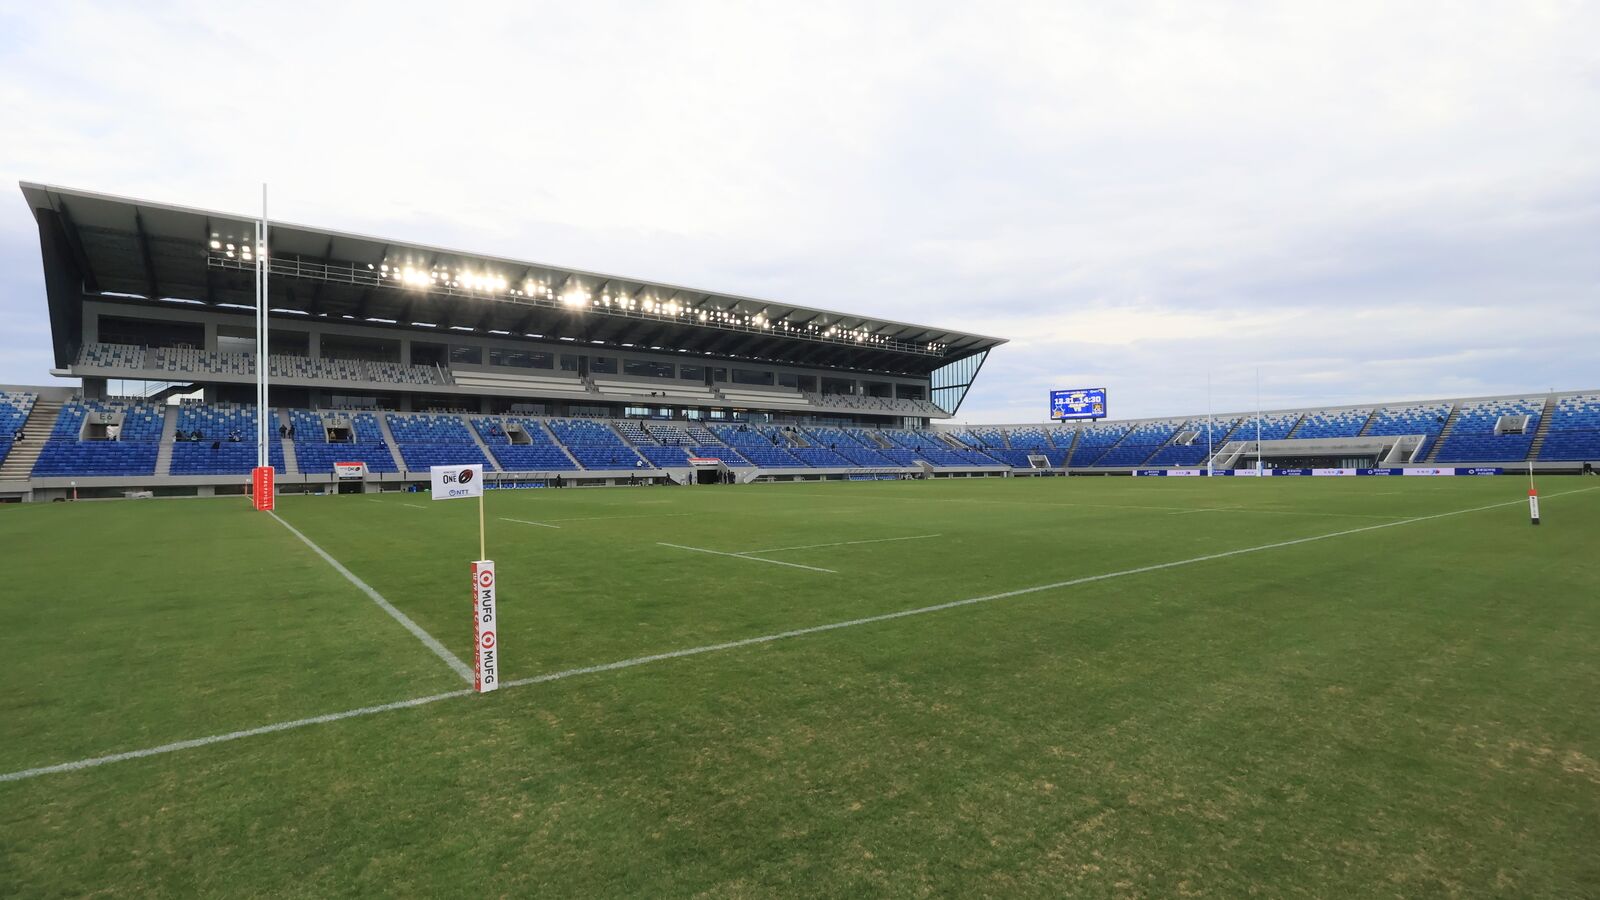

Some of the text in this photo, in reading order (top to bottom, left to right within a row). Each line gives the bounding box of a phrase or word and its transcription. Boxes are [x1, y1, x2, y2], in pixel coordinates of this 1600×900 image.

[443, 474, 457, 484] ONE
[482, 589, 493, 623] MUFG
[483, 650, 495, 684] MUFG
